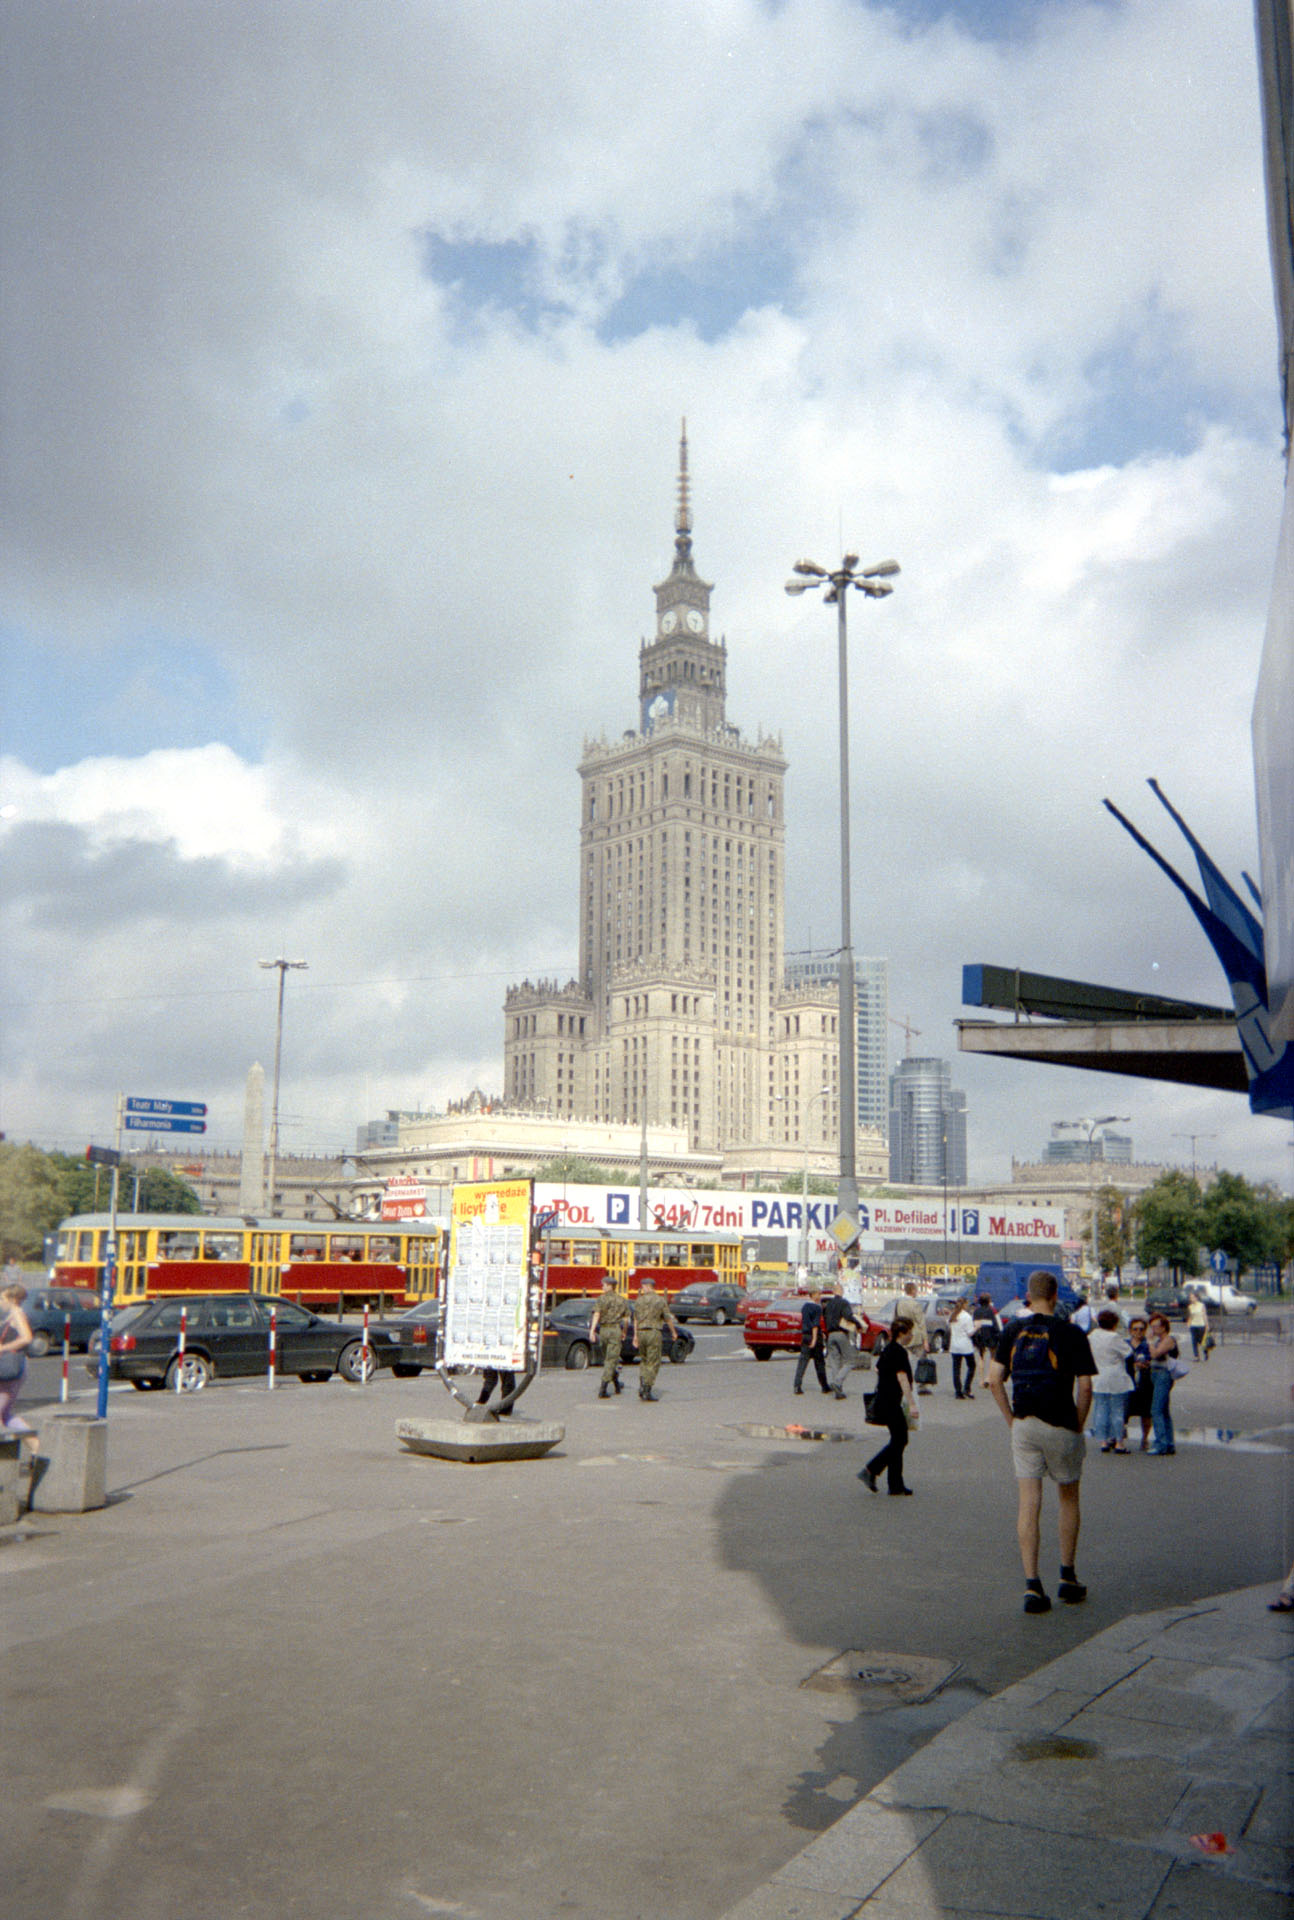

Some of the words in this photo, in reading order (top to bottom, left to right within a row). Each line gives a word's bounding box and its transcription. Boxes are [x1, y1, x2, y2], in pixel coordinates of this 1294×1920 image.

[132, 1099, 151, 1110] Teatr
[153, 1100, 173, 1114] Mały
[129, 1117, 172, 1129] Filharmonia
[752, 1200, 869, 1231] PARKIG
[894, 1209, 938, 1225] Defilad
